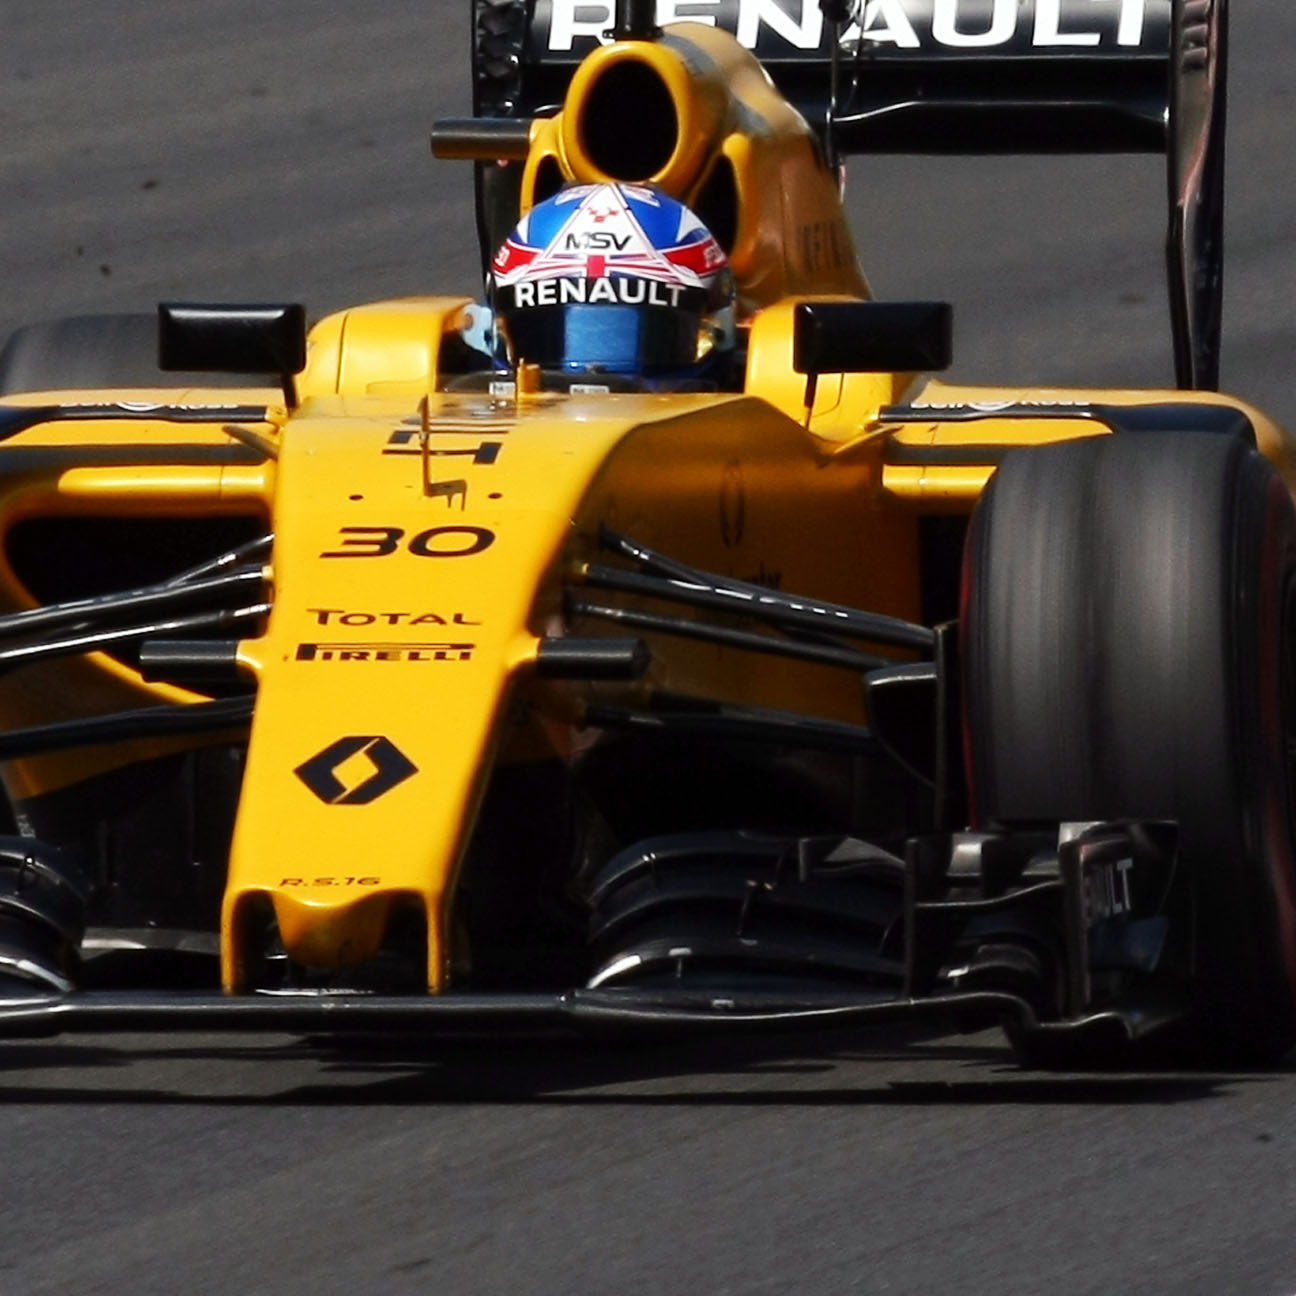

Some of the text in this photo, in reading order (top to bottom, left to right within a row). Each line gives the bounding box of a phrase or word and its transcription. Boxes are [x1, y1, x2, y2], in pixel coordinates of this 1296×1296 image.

[565, 232, 632, 251] MSV
[514, 277, 686, 308] RENAULT
[319, 525, 496, 558] 30
[306, 608, 483, 626] TOTAL
[295, 642, 476, 661] PIRELLI
[280, 877, 381, 887] R.S.16
